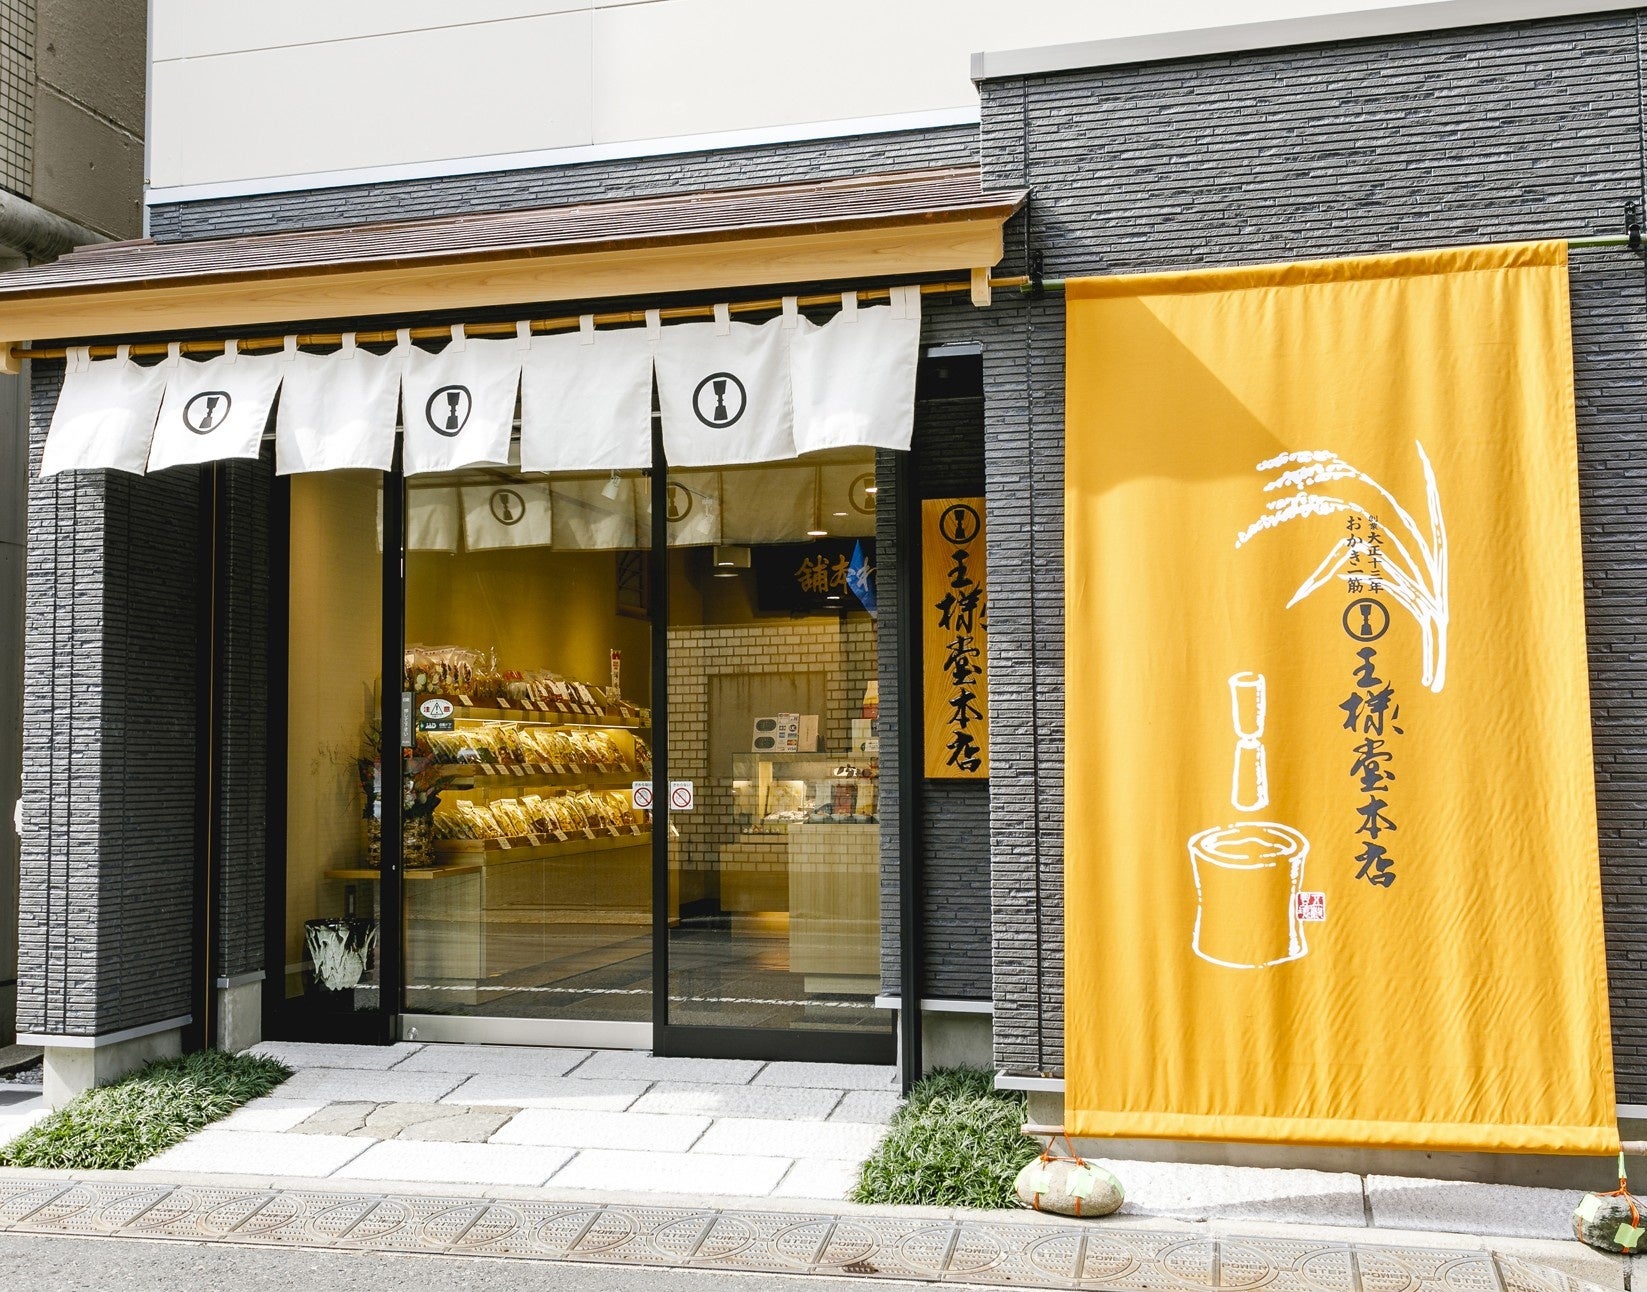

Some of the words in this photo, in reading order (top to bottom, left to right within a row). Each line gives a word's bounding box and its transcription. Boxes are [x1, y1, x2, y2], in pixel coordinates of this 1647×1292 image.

[1346, 515, 1364, 594] おかき一筋
[1368, 515, 1384, 594] 創業大正十三年
[934, 549, 988, 773] 王様堂本店
[1338, 647, 1404, 888] 王様堂本店
